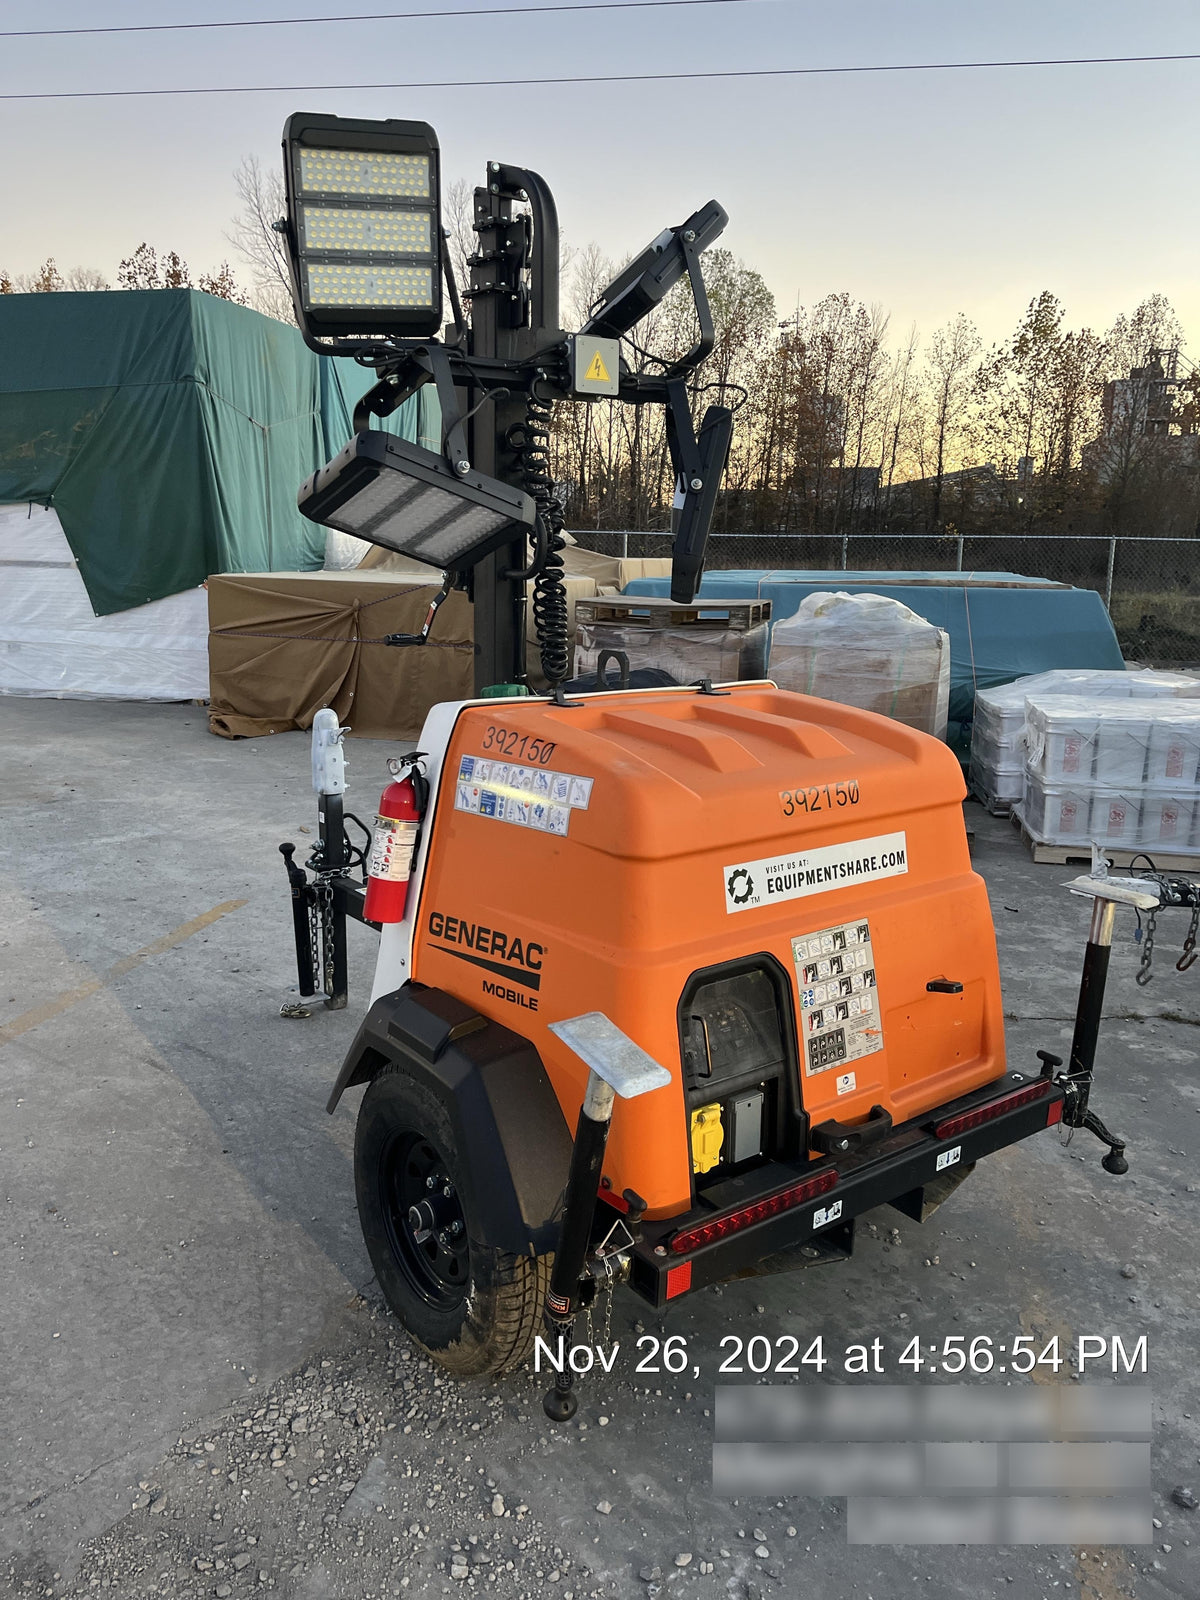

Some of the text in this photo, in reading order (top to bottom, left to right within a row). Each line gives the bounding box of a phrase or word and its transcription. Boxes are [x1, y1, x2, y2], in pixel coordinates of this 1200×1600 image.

[483, 726, 558, 764] 392150
[781, 779, 860, 816] 392150
[765, 859, 809, 875] VISIT US AT:
[767, 850, 905, 894] EQUIPMENTSHARE.COM
[750, 896, 761, 905] TM
[429, 911, 543, 970] GENERAC
[482, 980, 539, 1012] MOBILE
